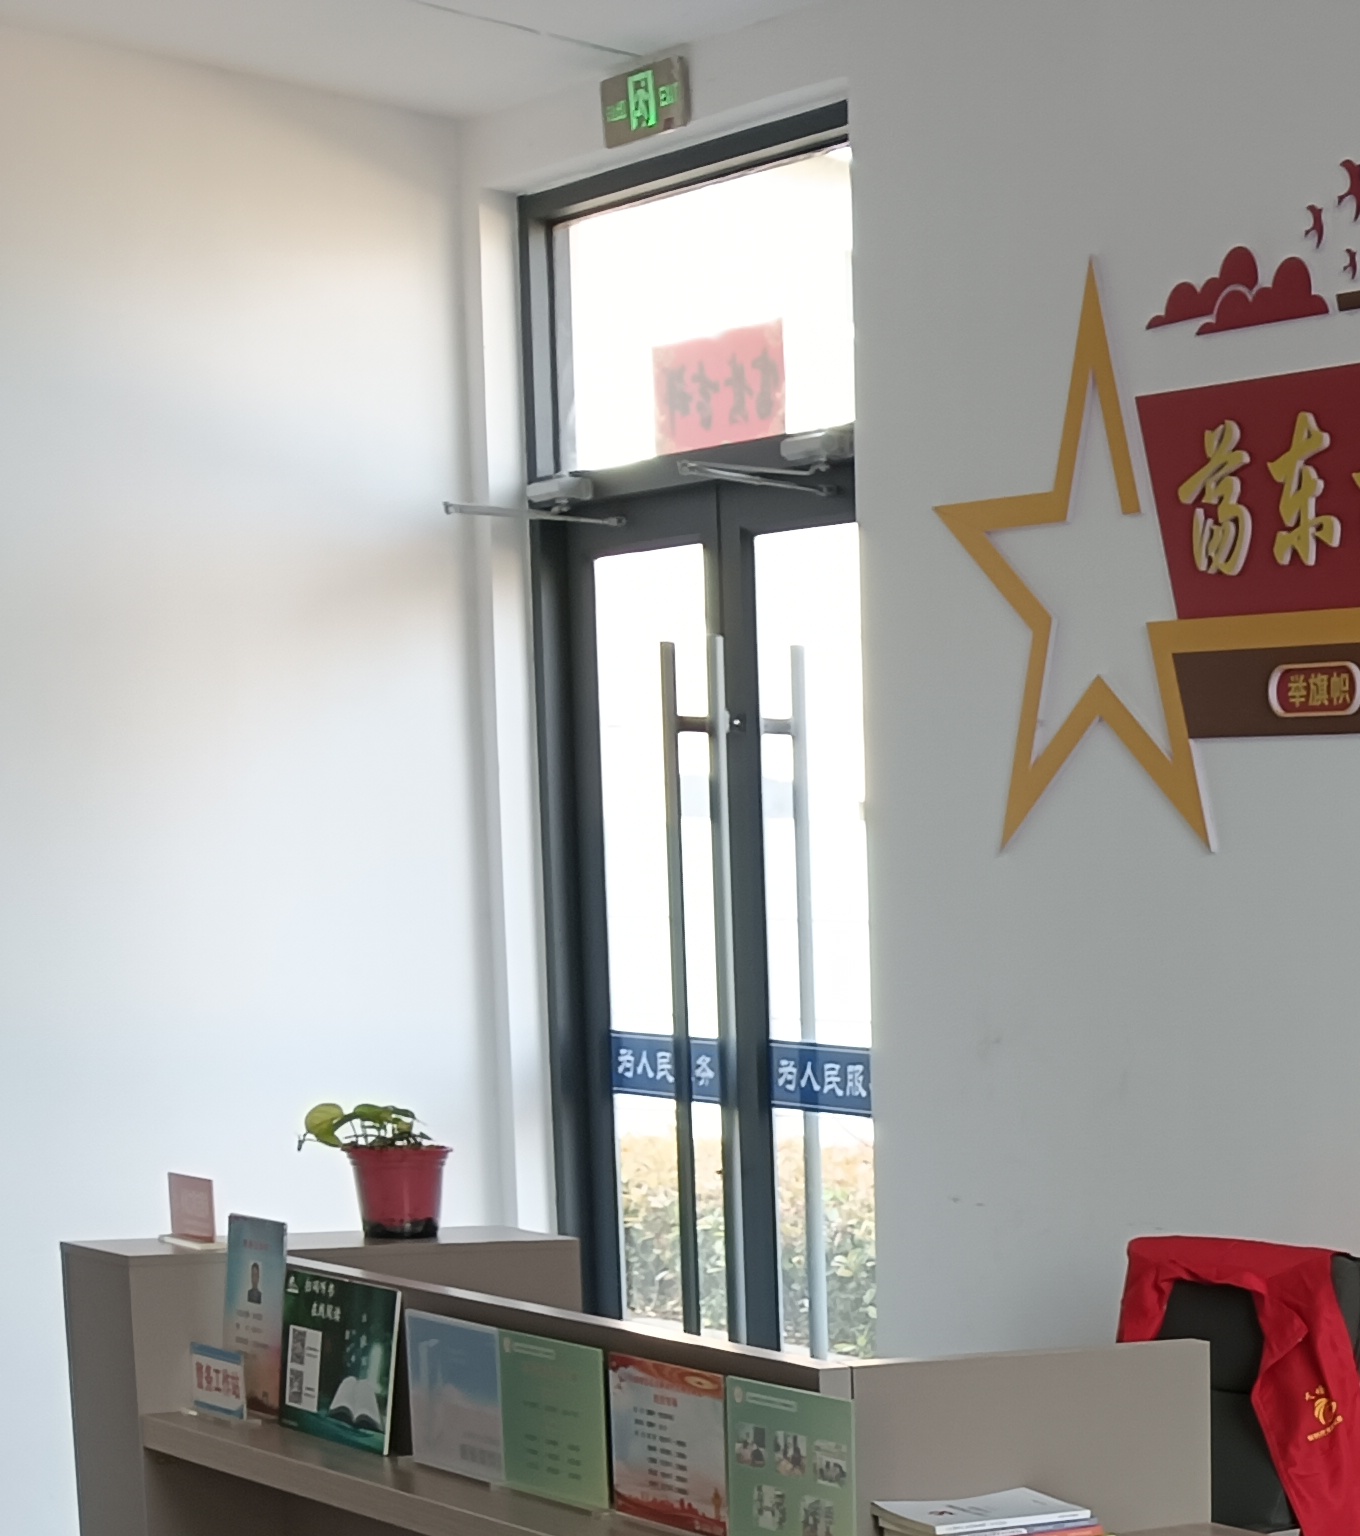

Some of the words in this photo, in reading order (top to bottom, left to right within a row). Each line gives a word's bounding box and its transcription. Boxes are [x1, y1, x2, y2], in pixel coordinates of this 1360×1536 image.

[1286, 671, 1350, 708] 举旗帜
[617, 1048, 715, 1086] 为人民务
